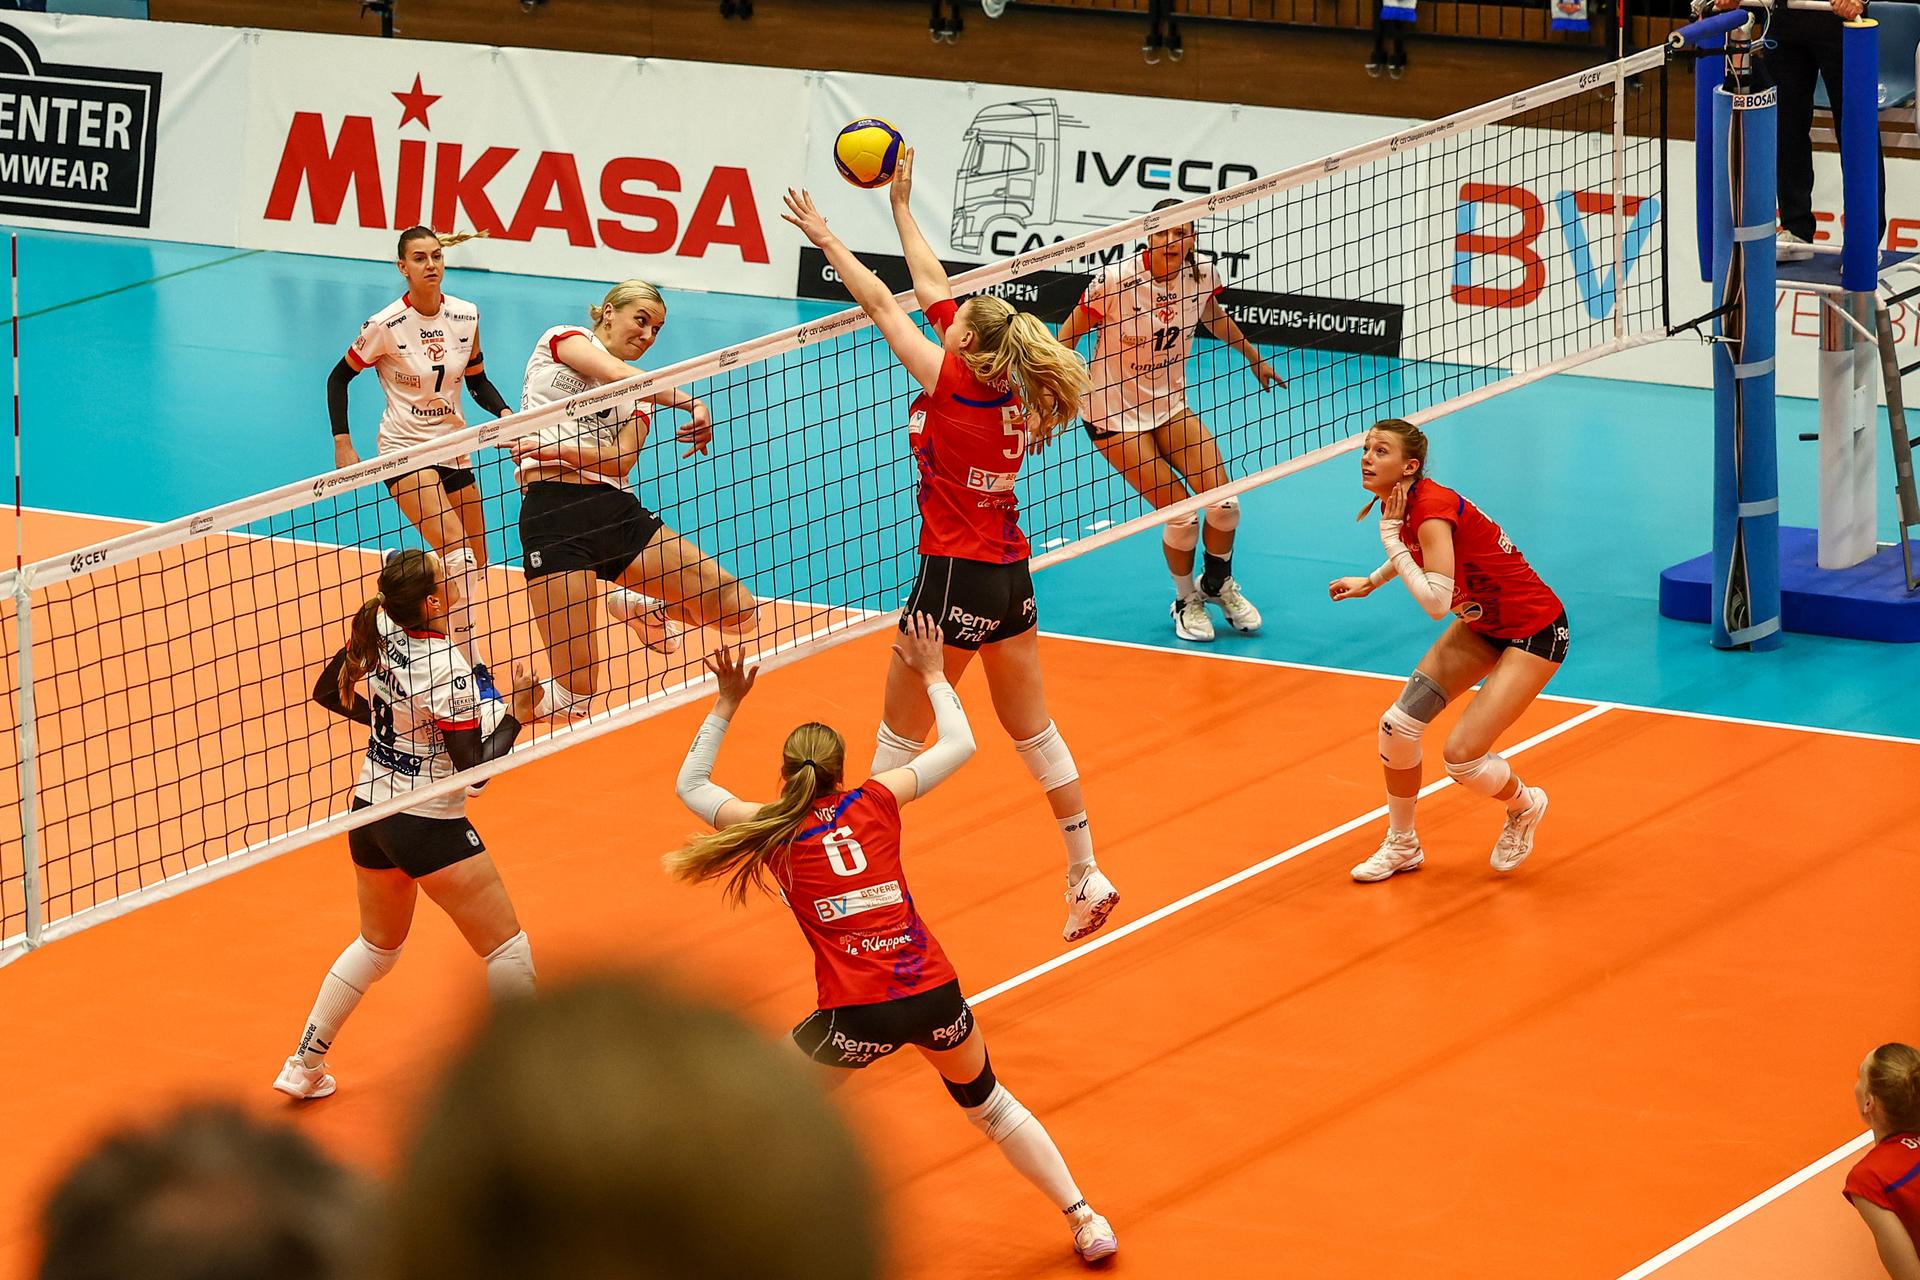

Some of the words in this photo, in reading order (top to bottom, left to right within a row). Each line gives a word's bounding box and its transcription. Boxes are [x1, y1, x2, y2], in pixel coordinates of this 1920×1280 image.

[1075, 150, 1258, 194] IVECO
[263, 111, 771, 265] MIKASA
[1451, 182, 1660, 319] BV
[1153, 326, 1180, 351] 12
[432, 364, 445, 393] 7
[1001, 404, 1027, 459] 5
[339, 469, 364, 487] Champions
[364, 465, 382, 479] League
[382, 461, 397, 472] Volley
[397, 456, 409, 466] 2025
[969, 470, 1000, 489] BV
[85, 549, 108, 566] CEV
[529, 550, 542, 568] 6
[948, 605, 1001, 631] Remo
[955, 626, 986, 642] Frit
[373, 693, 397, 746] 8
[814, 804, 836, 822] VOS
[465, 829, 480, 847] 8
[821, 825, 868, 877] 6
[816, 895, 848, 919] BV
[861, 934, 912, 952] Klapper
[831, 1031, 893, 1053] Remo
[838, 1053, 874, 1062] Frit
